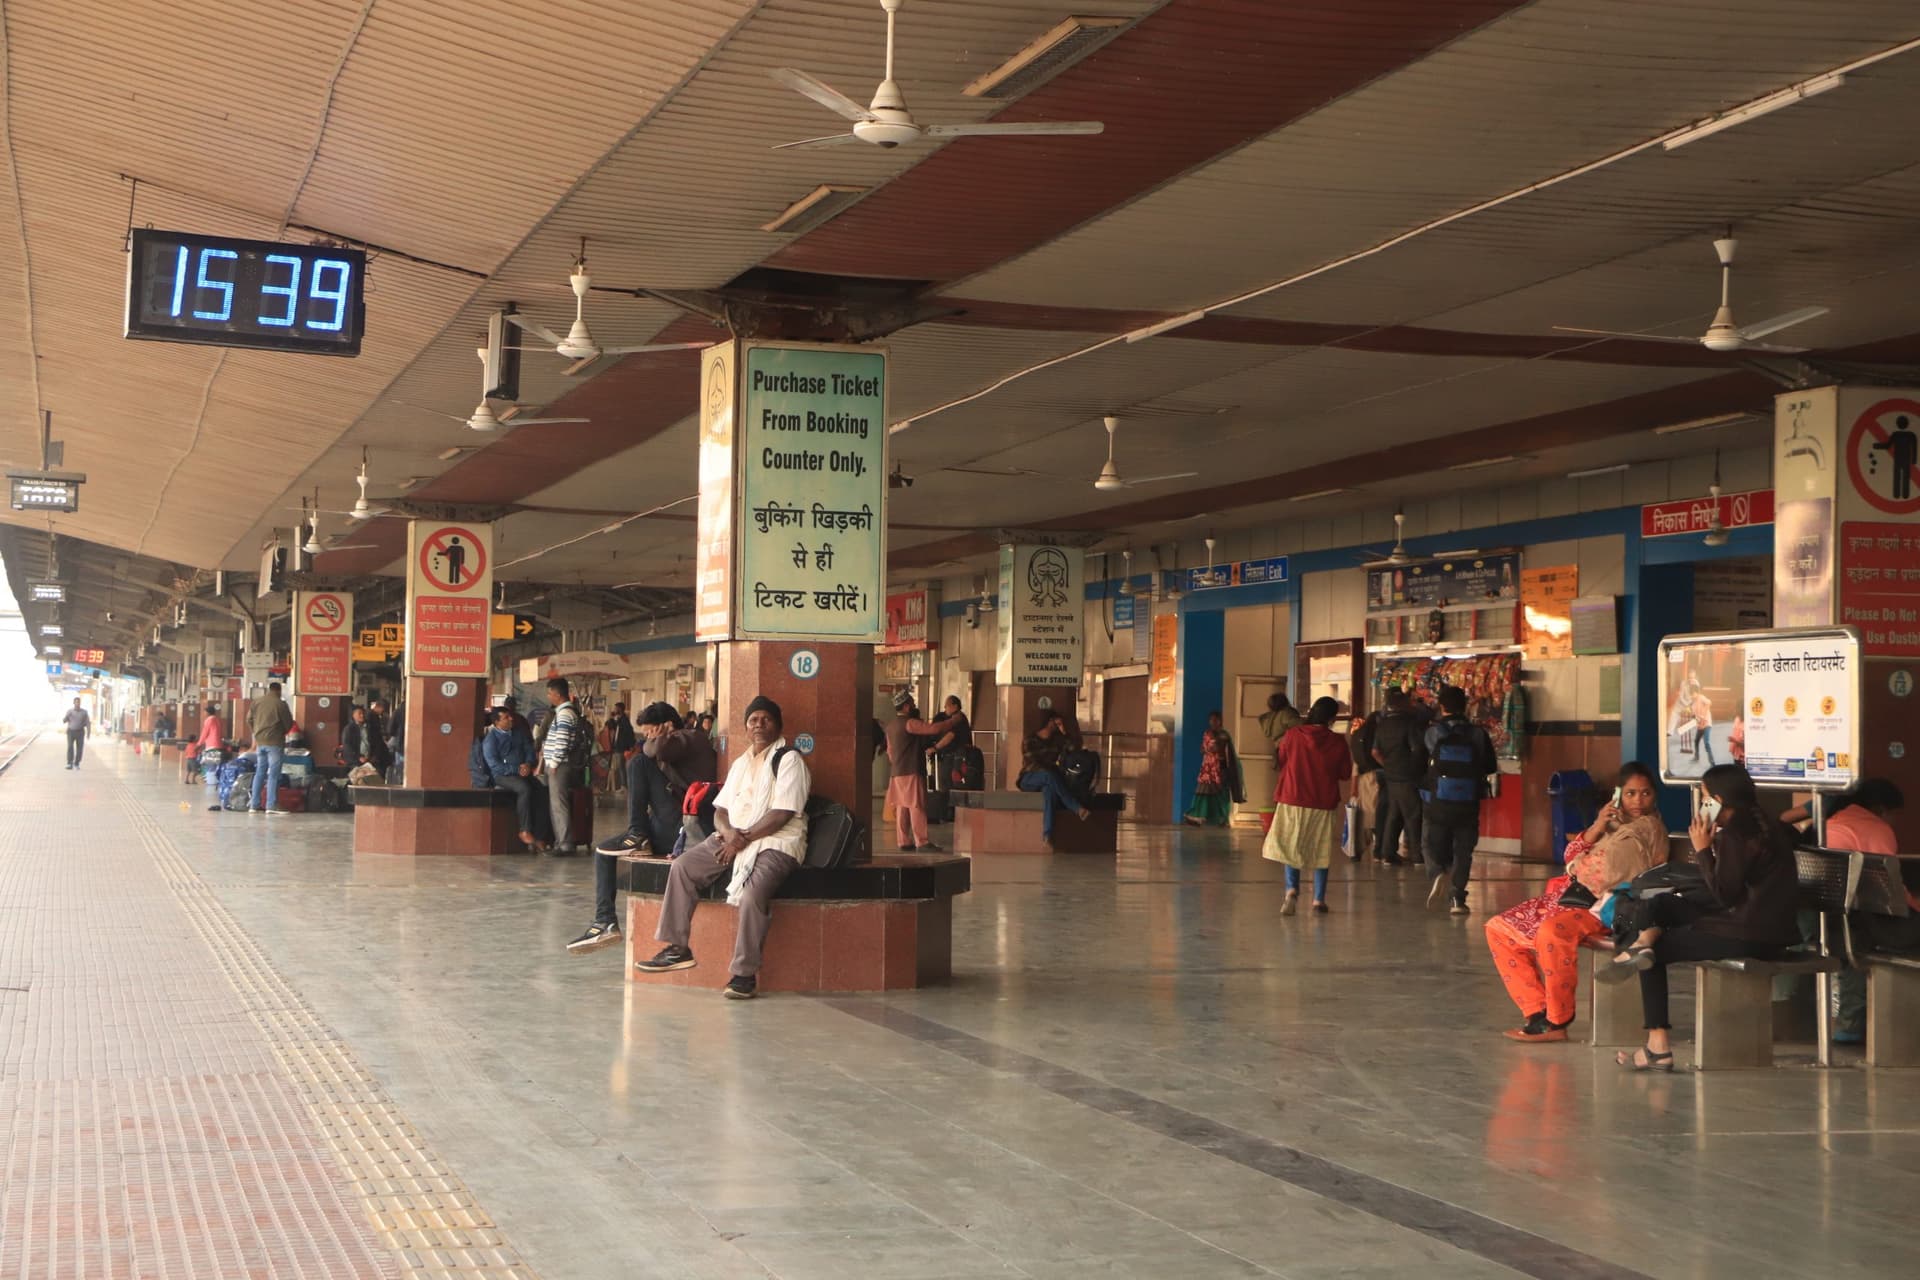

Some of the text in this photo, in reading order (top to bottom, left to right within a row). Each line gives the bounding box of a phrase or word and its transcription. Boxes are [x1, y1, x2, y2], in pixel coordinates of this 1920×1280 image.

[753, 370, 879, 398] Purchase Ticket
[762, 408, 869, 439] From Booking
[762, 447, 867, 478] Counter Only.
[753, 501, 874, 534] बुकिंग खिड़की
[1653, 508, 1688, 533] निकास
[792, 543, 834, 571] से ही
[754, 584, 807, 609] टिकट
[813, 584, 868, 611] खरीदें।
[1845, 607, 1917, 622] Please Do Not
[1867, 631, 1884, 645] Use
[417, 643, 439, 654] Please
[441, 644, 450, 653] Do
[452, 645, 463, 654] Not
[1025, 652, 1060, 660] WELCOME
[430, 656, 470, 667] Use Dustbin
[796, 656, 813, 674] 18
[1028, 664, 1068, 672] TATANAGAR
[1772, 652, 1800, 673] खेलता
[1803, 651, 1846, 672] रिटायरमेंट
[444, 683, 455, 694] 17
[1017, 676, 1047, 684] RAILWAY
